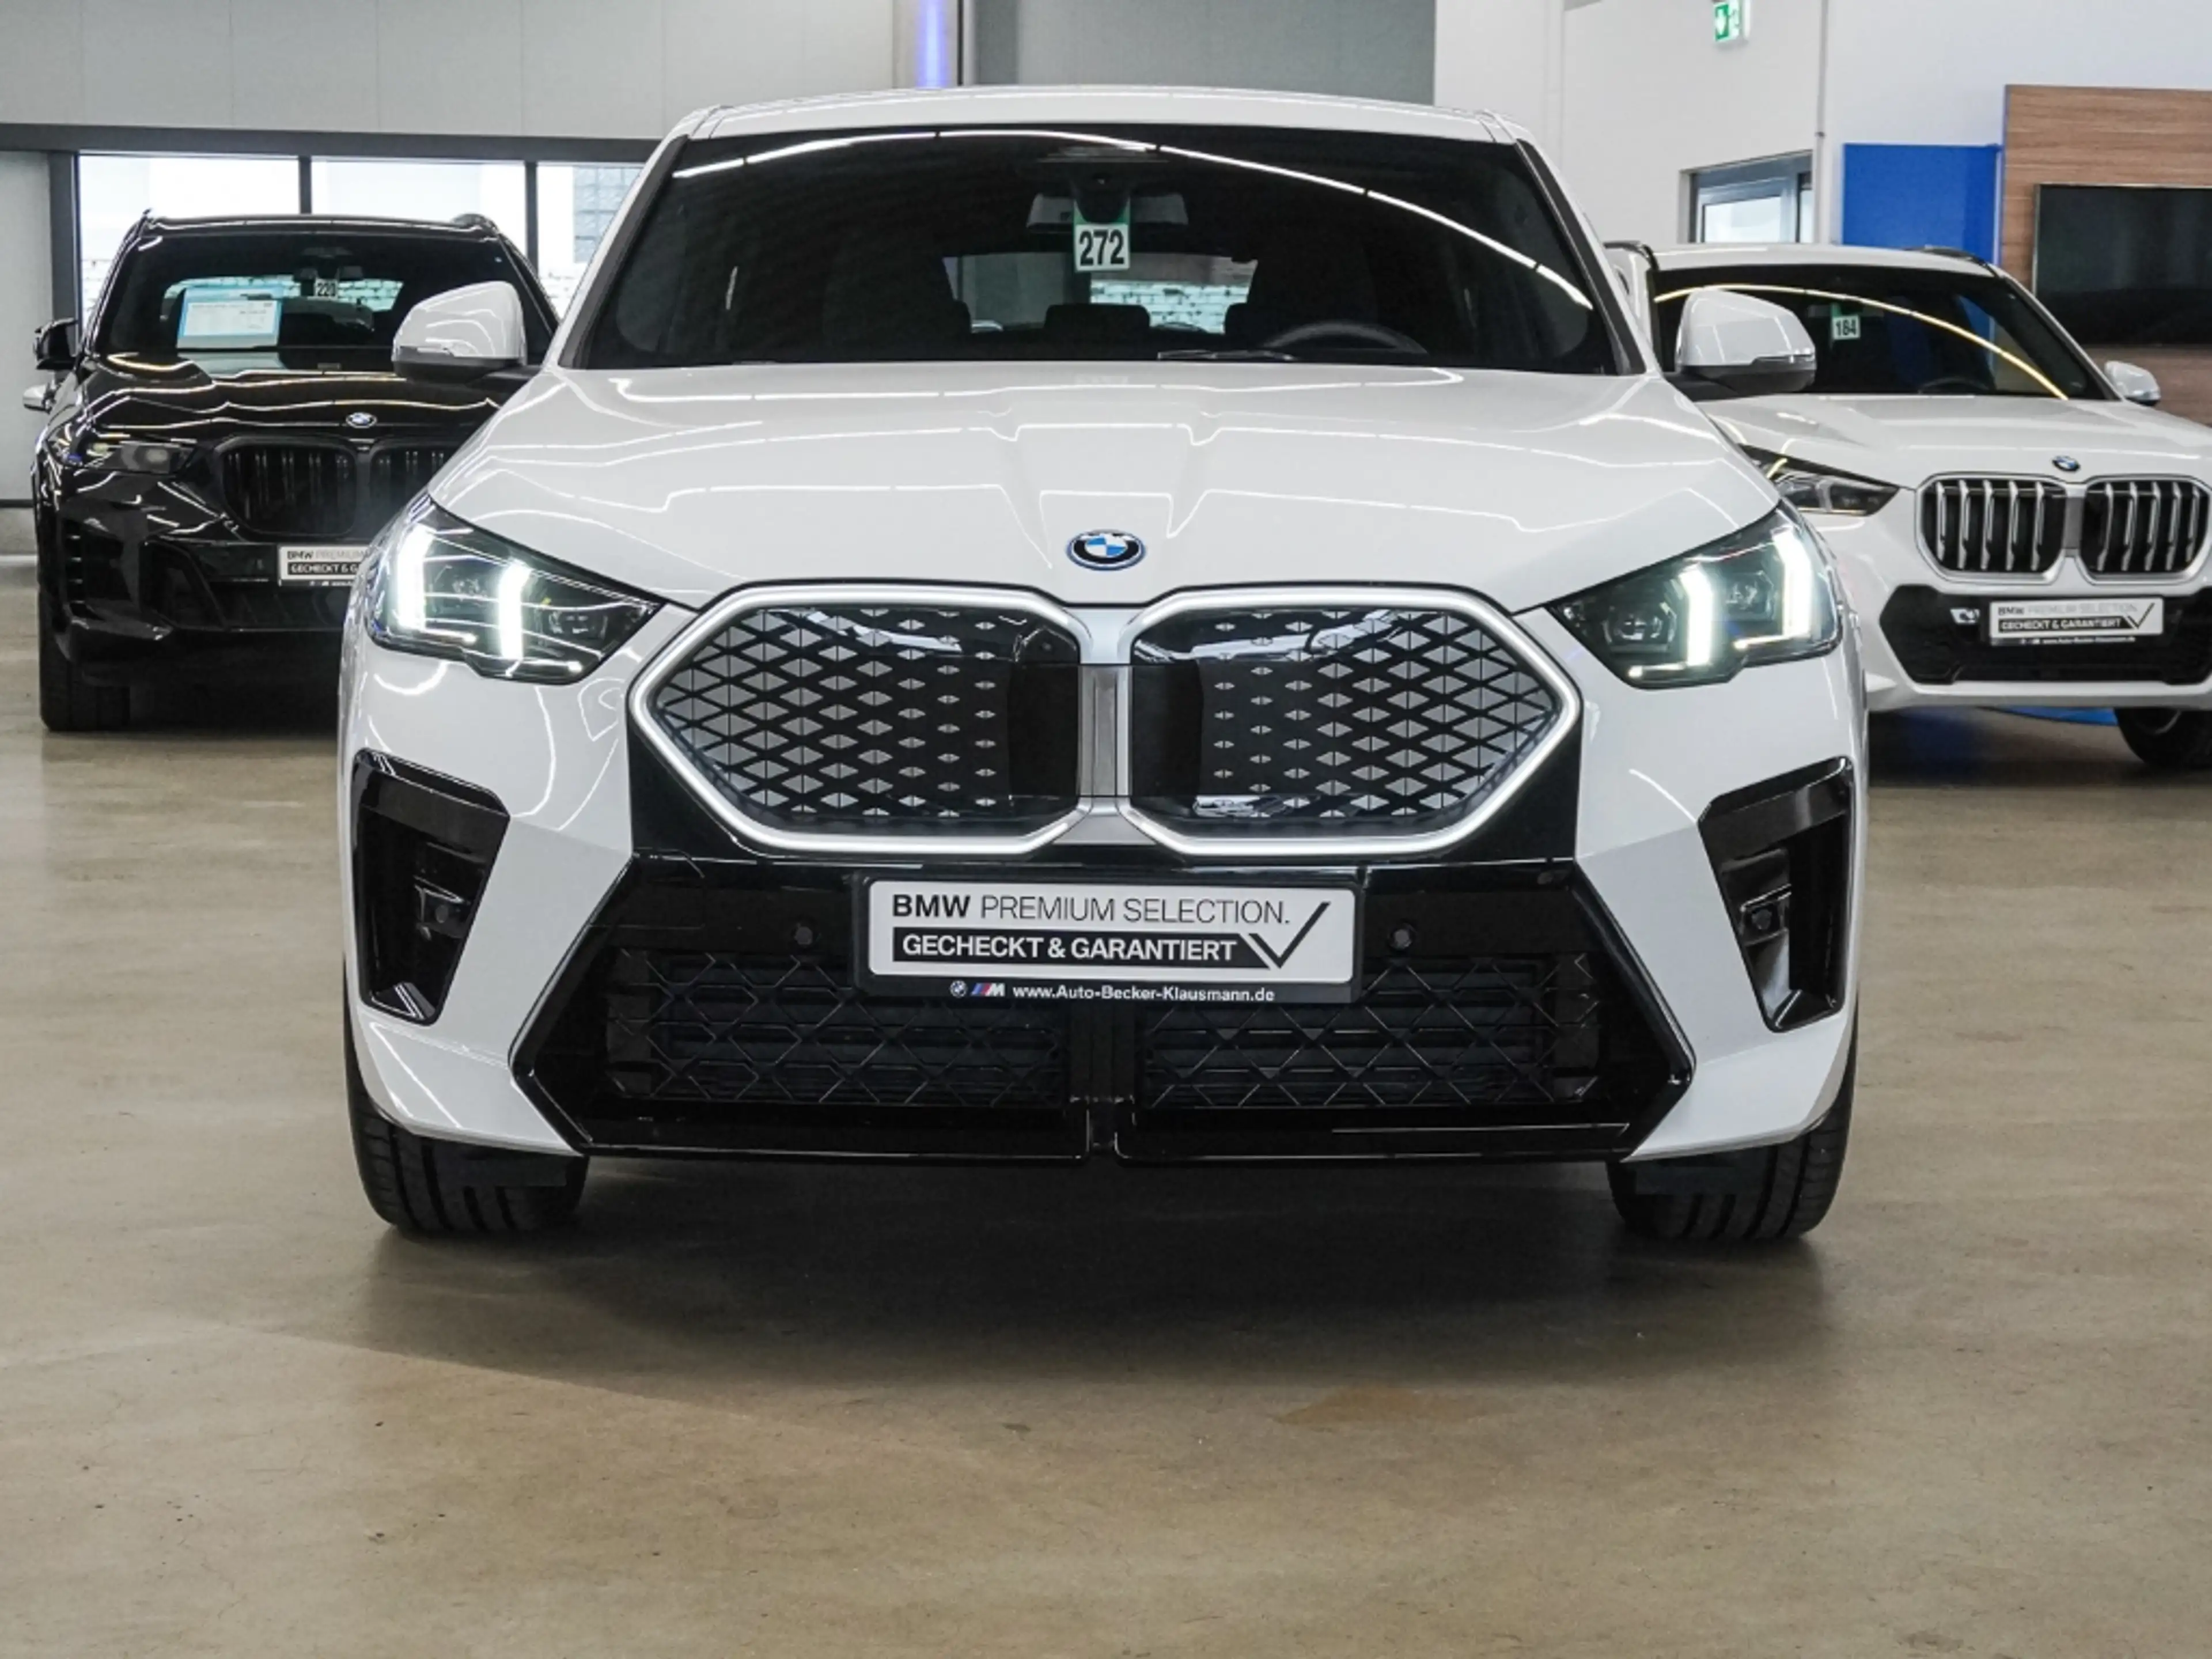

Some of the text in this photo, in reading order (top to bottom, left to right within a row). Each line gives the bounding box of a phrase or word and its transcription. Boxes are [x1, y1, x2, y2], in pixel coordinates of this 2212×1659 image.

[1079, 229, 1124, 266] 272
[317, 282, 336, 297] 220
[1835, 319, 1856, 336] 184
[288, 551, 314, 560] BMW
[1998, 606, 2025, 616] BMW
[893, 894, 1290, 924] BMW PREMIUM SELECTION.
[902, 934, 1238, 961] GECHECKT & GARANTIERT
[1012, 984, 1275, 1002] www.Auto-Becker-Klausmann.de
